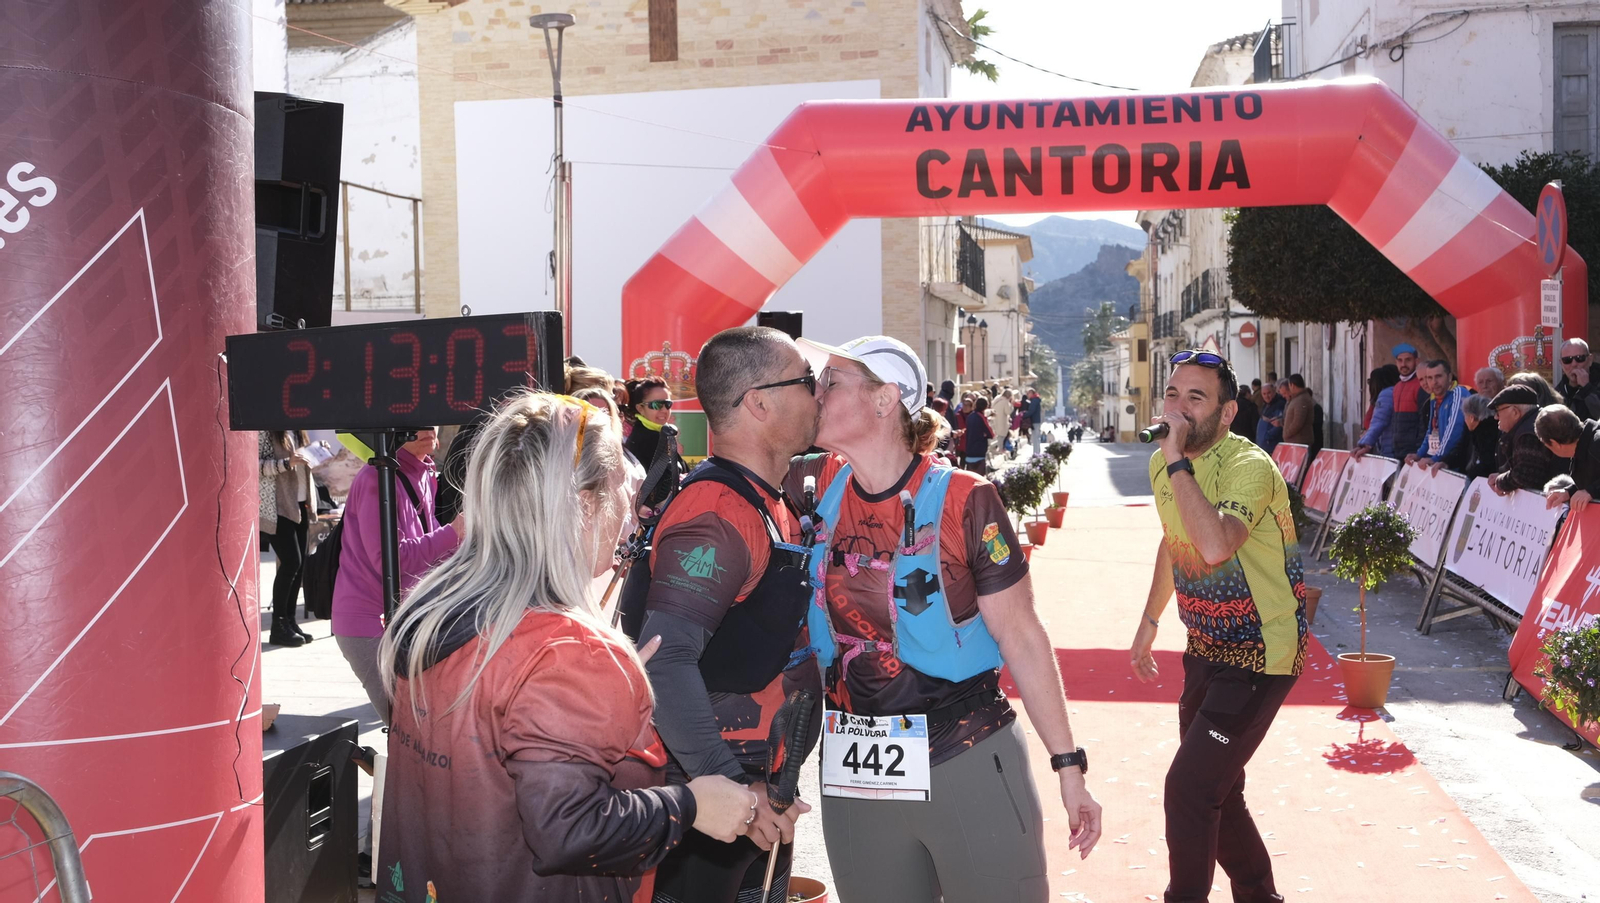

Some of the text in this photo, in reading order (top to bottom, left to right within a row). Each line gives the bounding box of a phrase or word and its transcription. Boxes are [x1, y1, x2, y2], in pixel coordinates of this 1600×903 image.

[905, 92, 1263, 132] AYUNTAMIENTO
[915, 139, 1251, 199] CANTORIA
[1479, 506, 1549, 546] AYUNTAMIENTO DE
[683, 555, 712, 577] FAM
[1467, 524, 1541, 585] CANTORIA
[836, 726, 846, 734] LA
[842, 742, 905, 777] 442
